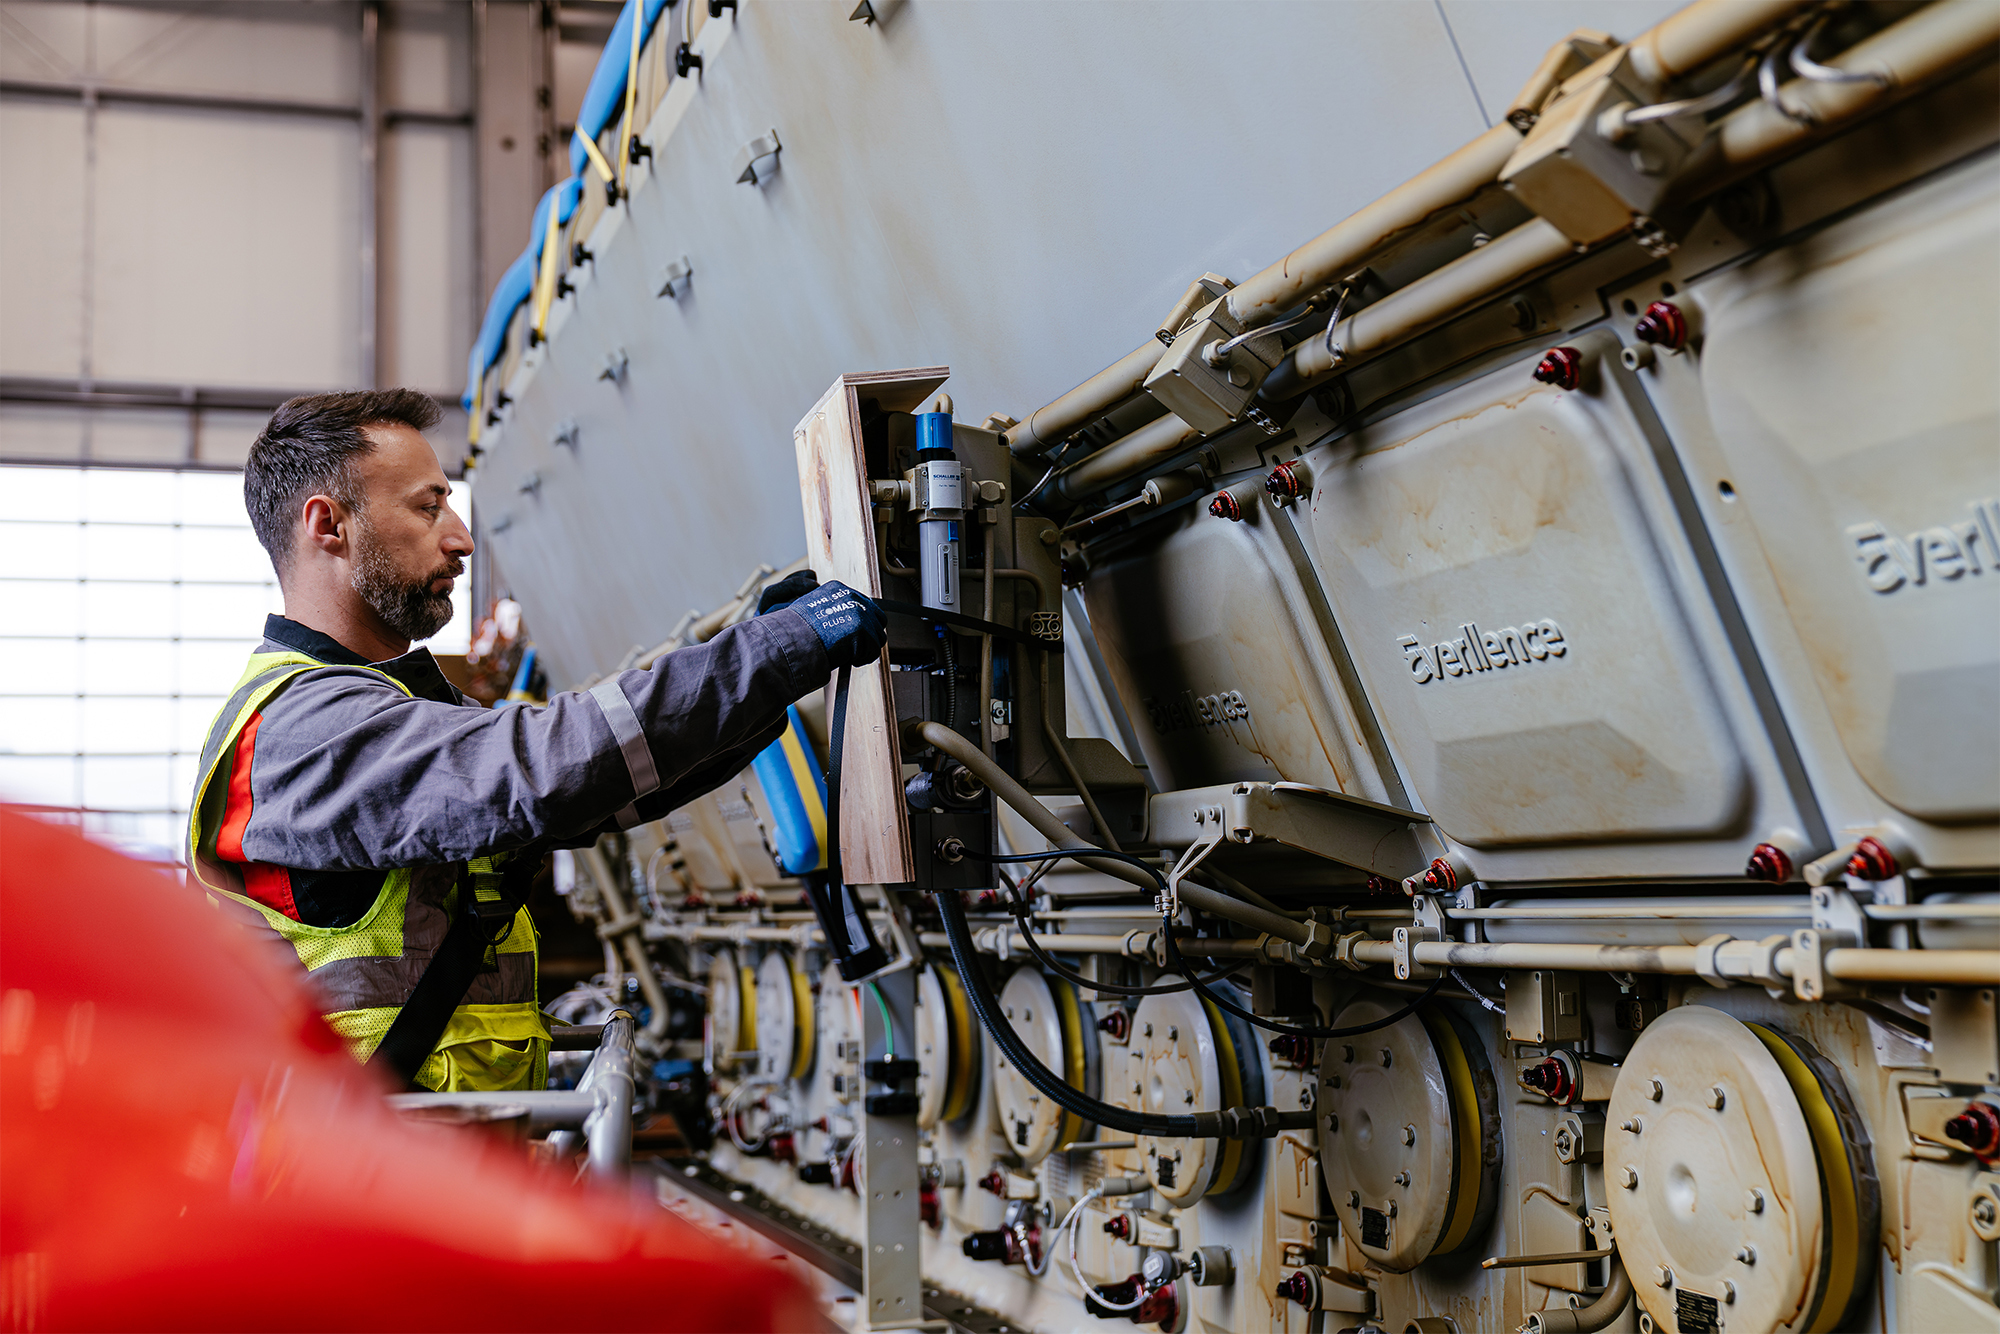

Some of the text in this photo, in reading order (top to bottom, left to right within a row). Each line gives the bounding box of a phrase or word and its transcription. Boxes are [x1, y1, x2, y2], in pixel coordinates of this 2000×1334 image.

[822, 614, 853, 629] PLUS 3
[1396, 617, 1568, 685] Everllence
